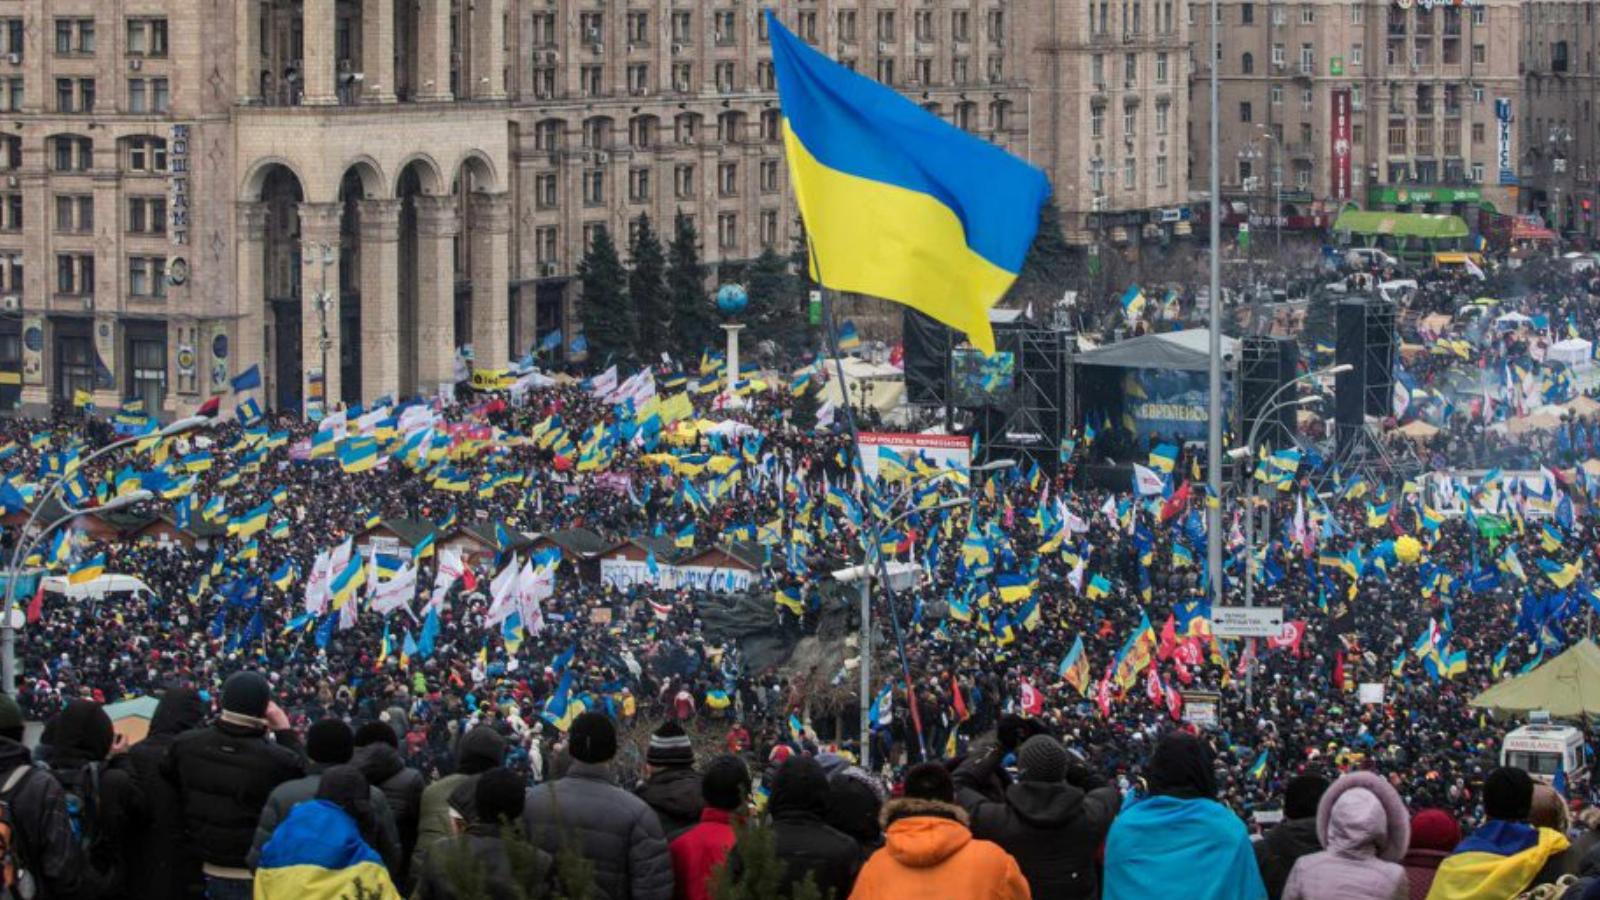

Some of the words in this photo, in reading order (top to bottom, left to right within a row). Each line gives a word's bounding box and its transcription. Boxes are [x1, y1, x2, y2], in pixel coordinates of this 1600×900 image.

[172, 124, 187, 244] ПОШТАМТ
[1141, 403, 1209, 421] ЄВРОПЕЙСЬ
[858, 435, 876, 443] STOP
